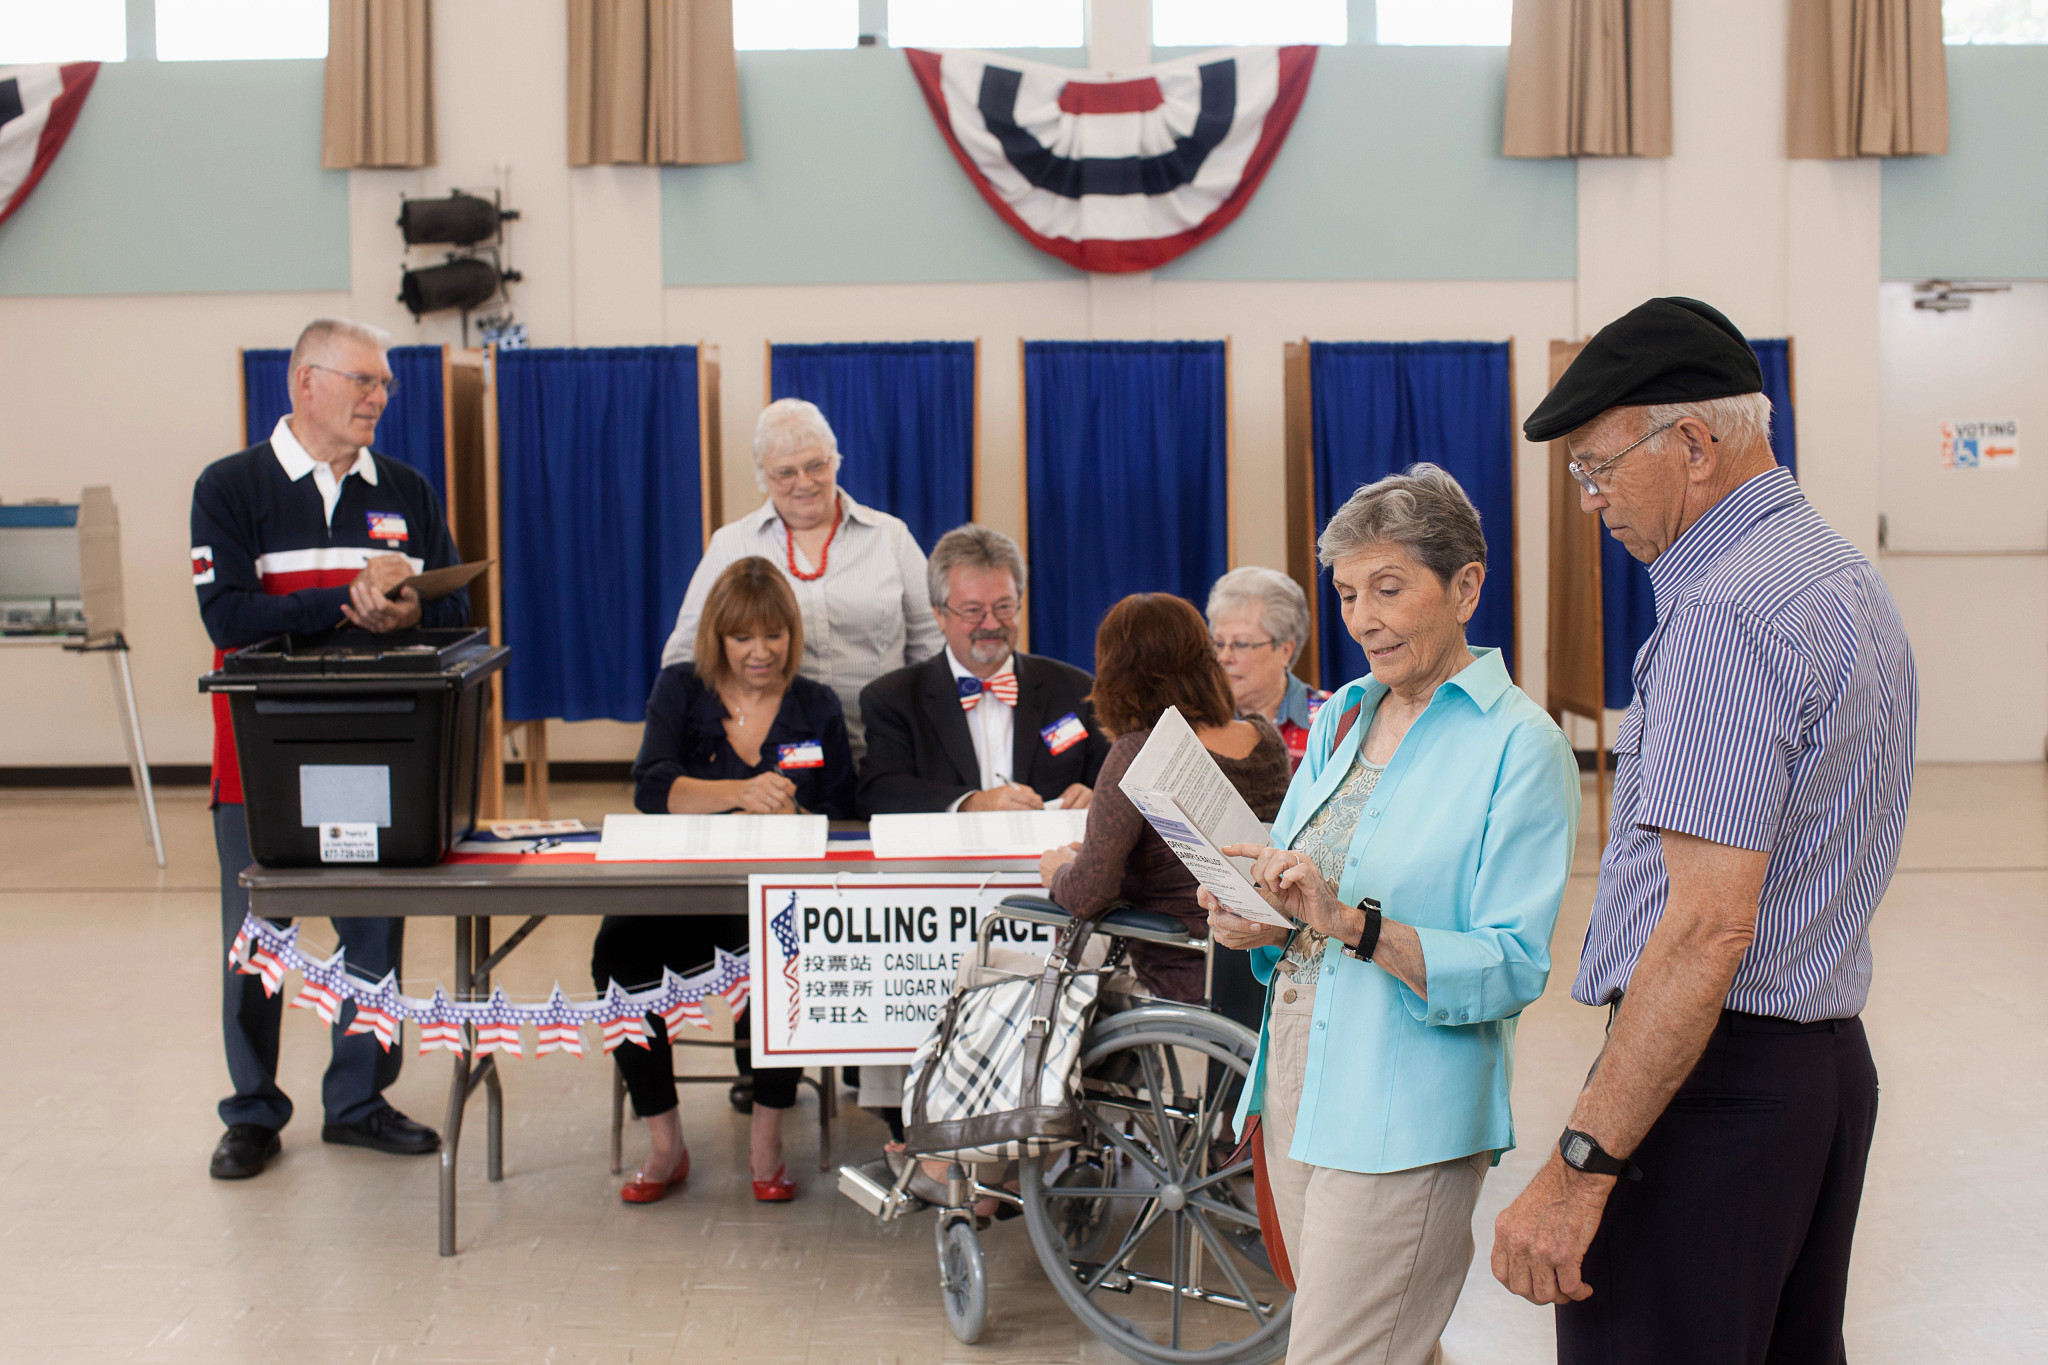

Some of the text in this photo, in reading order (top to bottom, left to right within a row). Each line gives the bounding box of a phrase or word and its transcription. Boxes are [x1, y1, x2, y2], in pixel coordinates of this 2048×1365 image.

[1955, 421, 2017, 437] VOTING
[804, 906, 1049, 944] POLLING PLACE
[804, 955, 873, 972] 投票站
[884, 953, 947, 971] CASILLA
[805, 980, 873, 997] 投票所
[884, 979, 937, 997] LUGAR
[808, 1005, 868, 1024] 투표소
